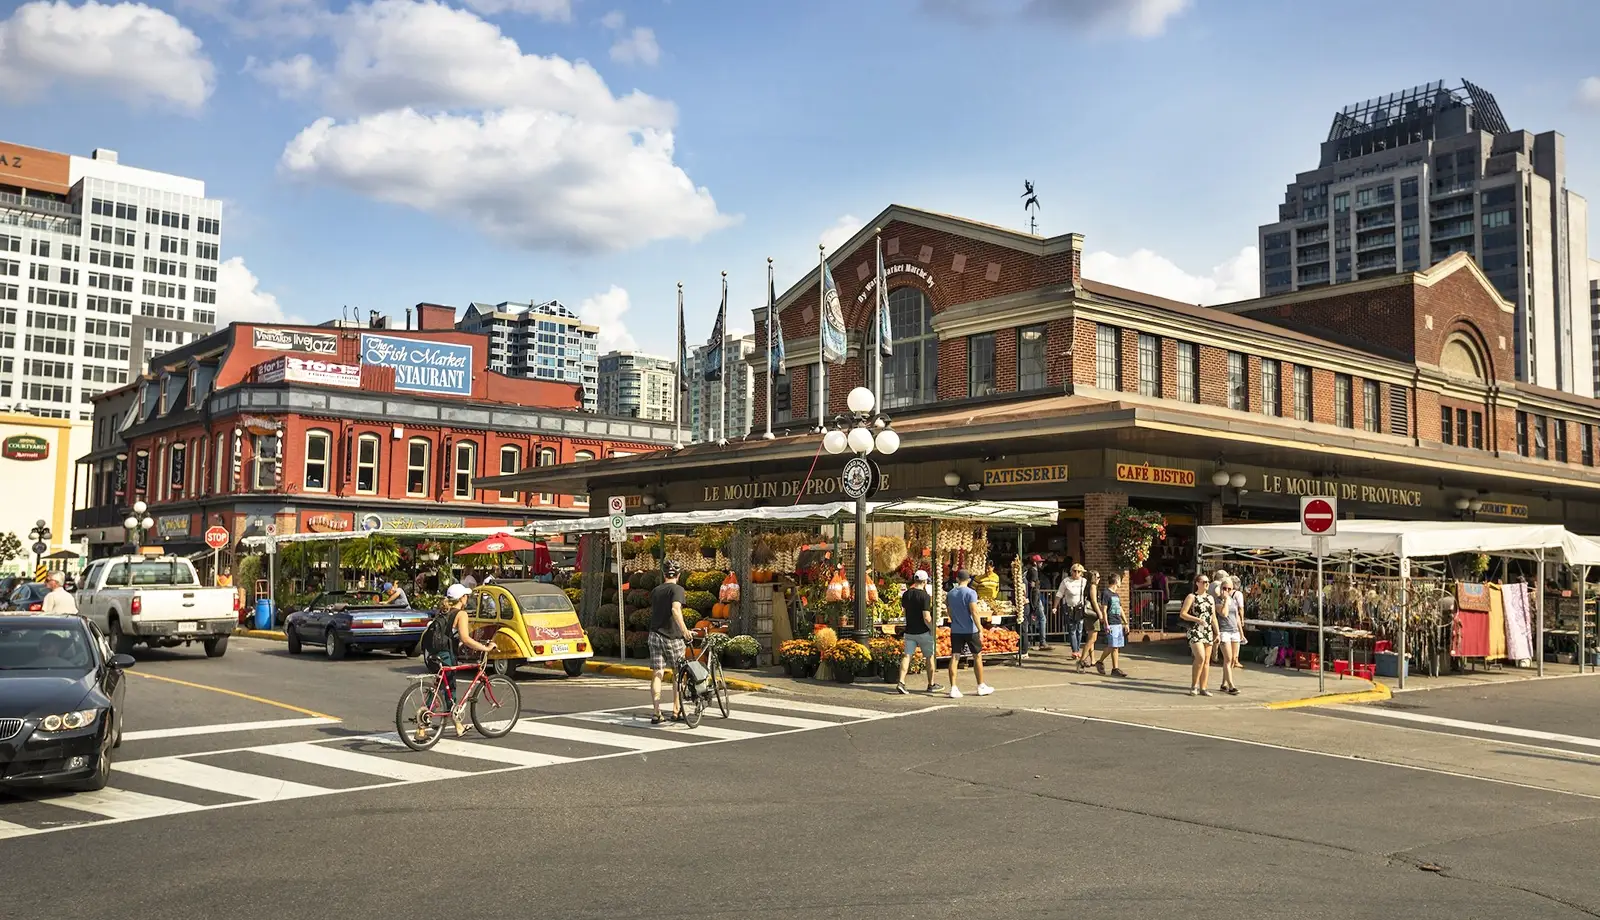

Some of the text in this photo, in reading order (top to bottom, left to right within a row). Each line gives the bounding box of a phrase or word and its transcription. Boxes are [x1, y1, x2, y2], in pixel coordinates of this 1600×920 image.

[884, 264, 904, 277] arket
[366, 337, 388, 350] The
[366, 345, 467, 368] Fish Market
[381, 363, 465, 389] STAURANT
[985, 466, 1066, 485] PATISSERIE
[1118, 461, 1194, 485] CAFÉ BISTRO
[704, 473, 890, 502] LE MOULIN DE PROVE
[1263, 474, 1422, 507] LE MOULIN DE PROVENCE
[1480, 502, 1508, 515] OURMET
[207, 532, 227, 542] STOP
